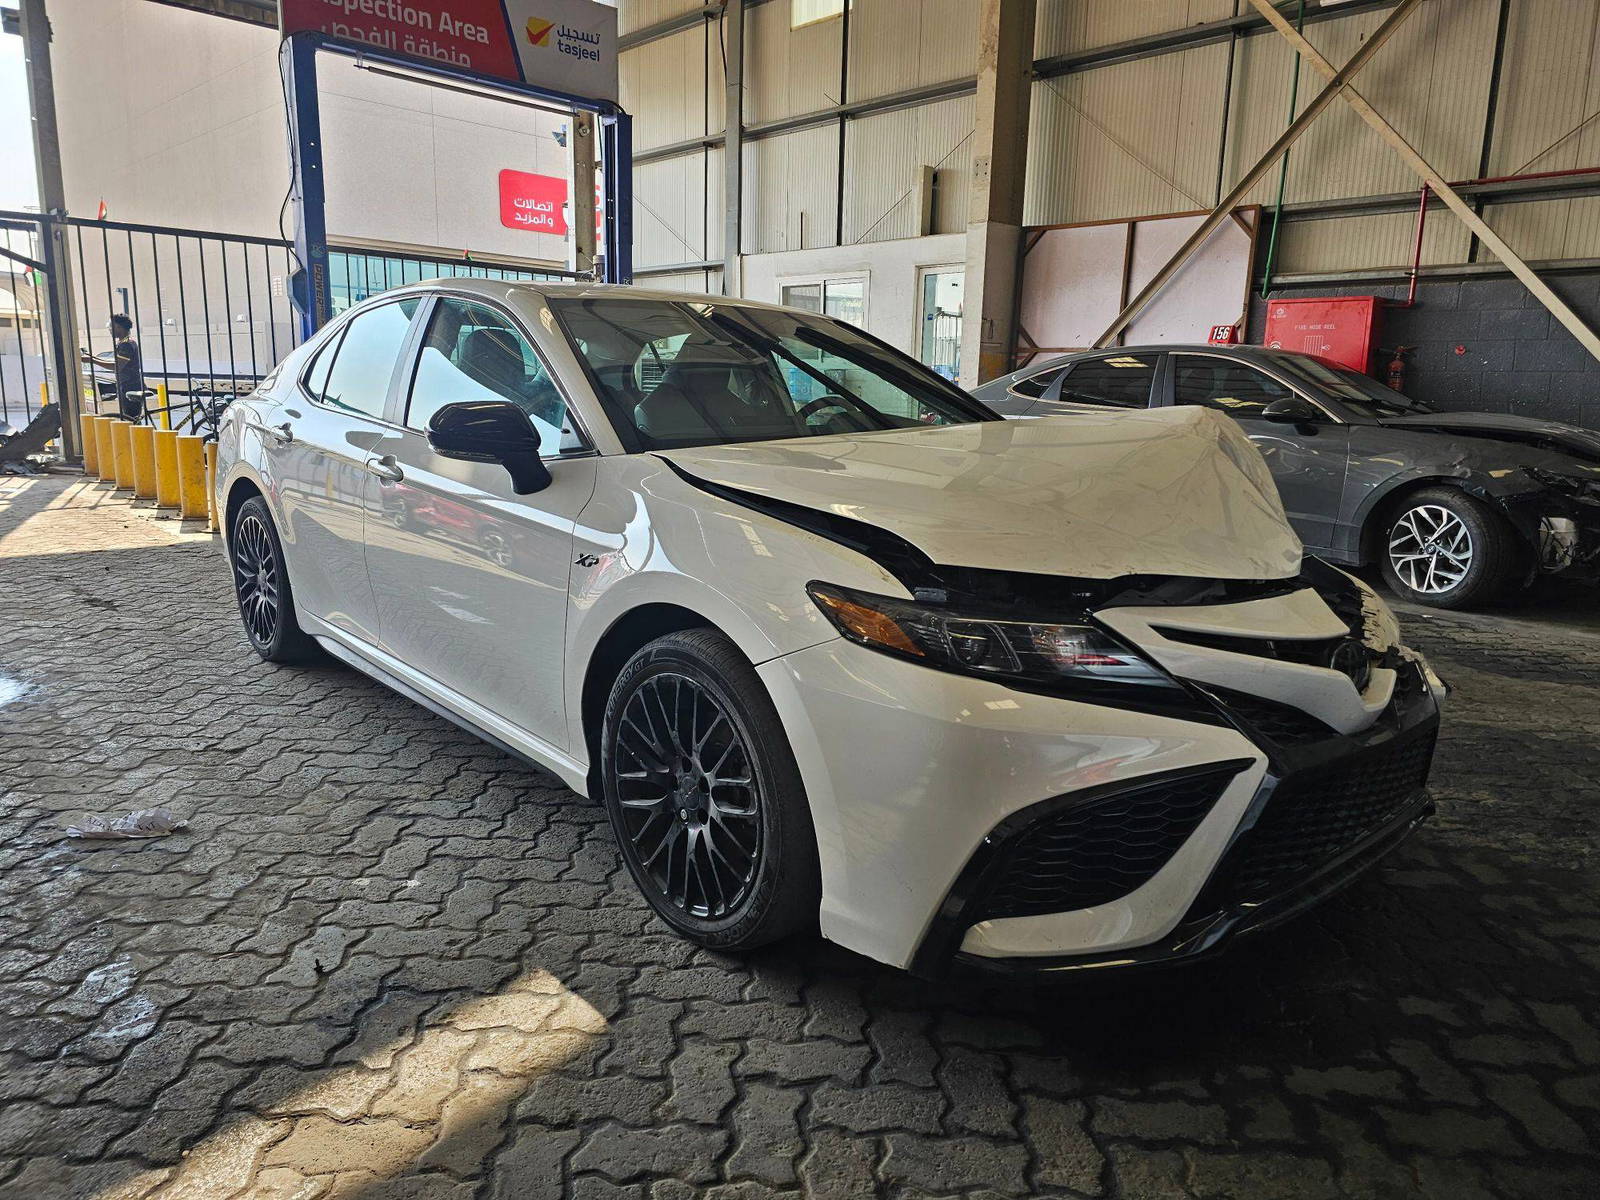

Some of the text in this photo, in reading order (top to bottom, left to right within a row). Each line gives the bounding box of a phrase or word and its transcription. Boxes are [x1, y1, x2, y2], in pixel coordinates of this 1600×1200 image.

[323, 0, 490, 45] pection Area
[557, 25, 600, 45] تسجيل
[557, 39, 600, 62] tasjeel
[514, 197, 553, 212] اتصالات
[1212, 326, 1230, 340] 156
